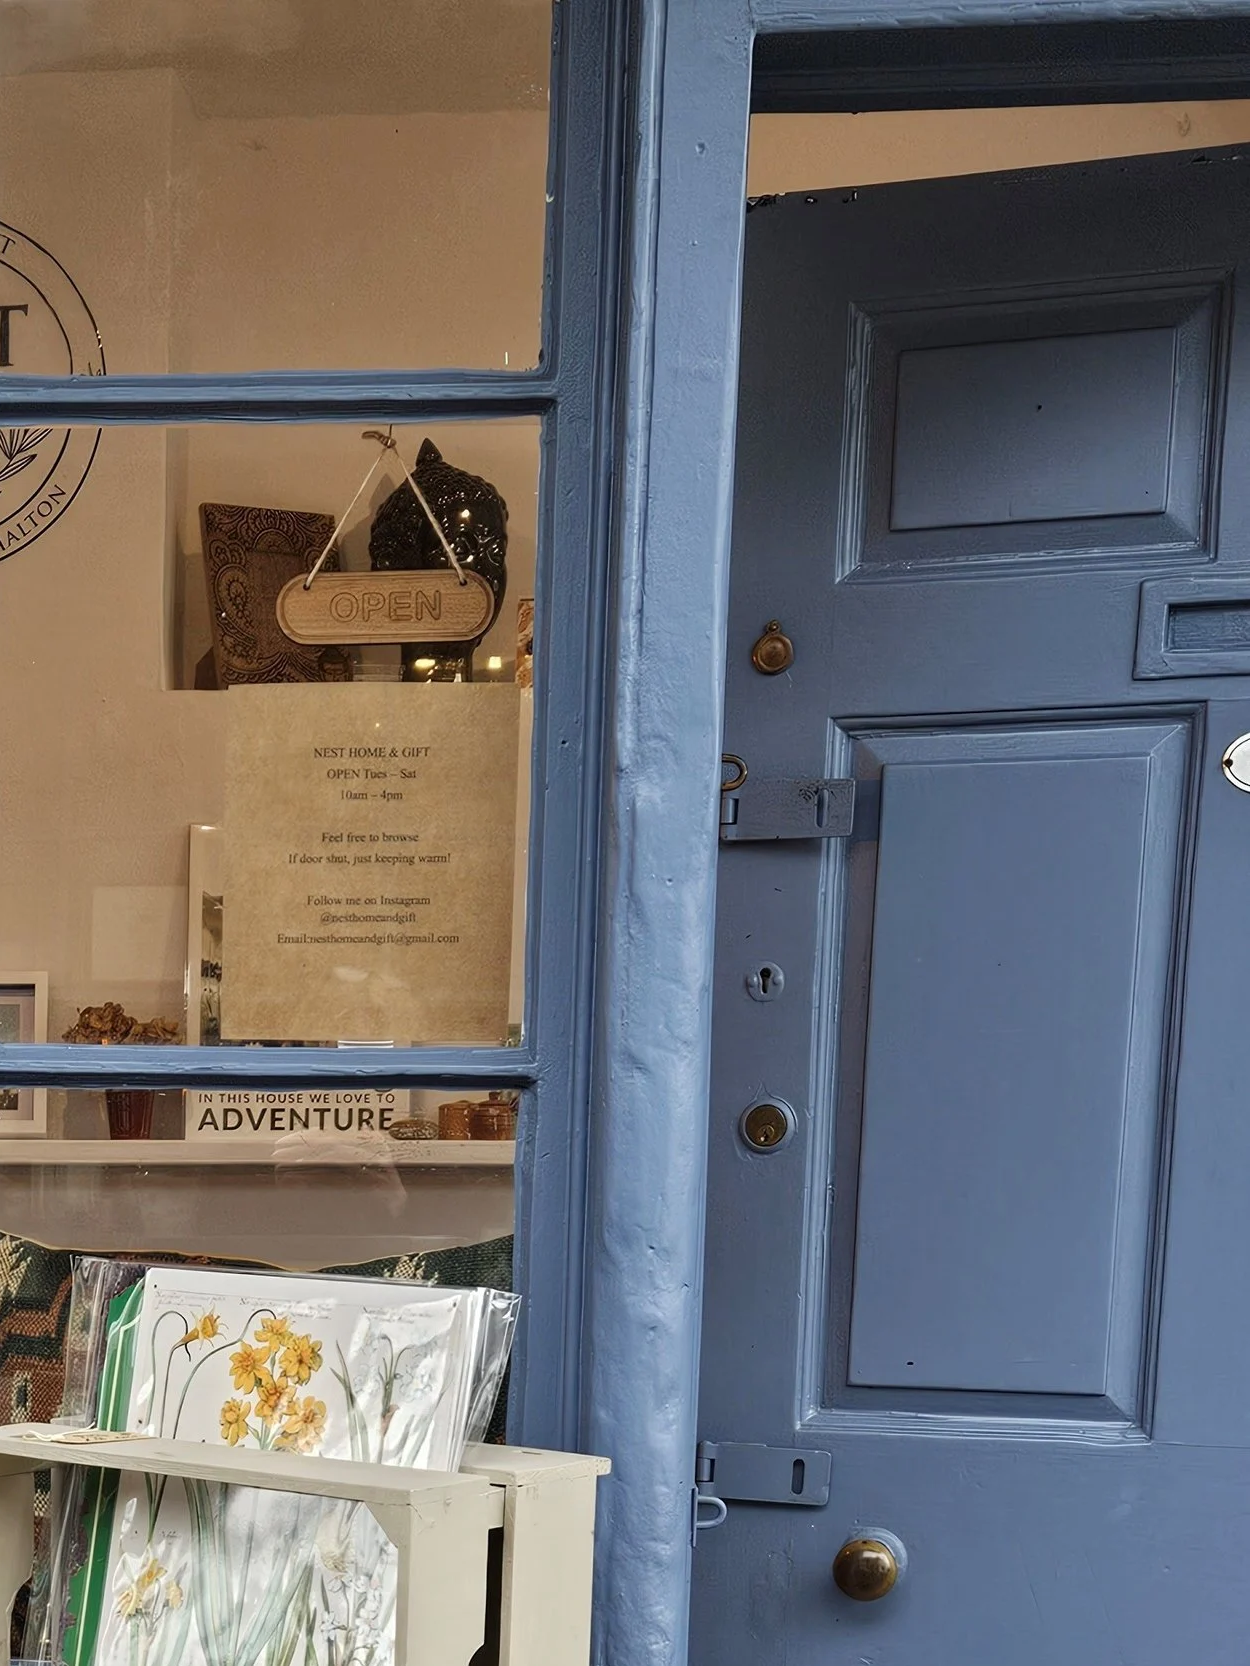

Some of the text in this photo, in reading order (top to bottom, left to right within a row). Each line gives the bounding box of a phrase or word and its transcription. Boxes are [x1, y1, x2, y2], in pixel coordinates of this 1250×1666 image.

[329, 590, 441, 623] OPEN
[313, 746, 431, 758] NEST HOME & GIFT
[326, 768, 360, 779] OPEN
[363, 768, 387, 779] Tues
[400, 768, 417, 779] Sat
[340, 790, 368, 800] 10am
[380, 790, 403, 802] 4pm
[321, 832, 419, 843] Feel free to browse
[288, 853, 451, 866] If door shut, just keeping warm!
[307, 895, 431, 907] Follow me on Instagram
[320, 912, 417, 925] @nesthomeandgift
[199, 1093, 395, 1104] IN THIS HOUSE WE LOVE TO
[198, 1107, 394, 1131] ADVENTURE
